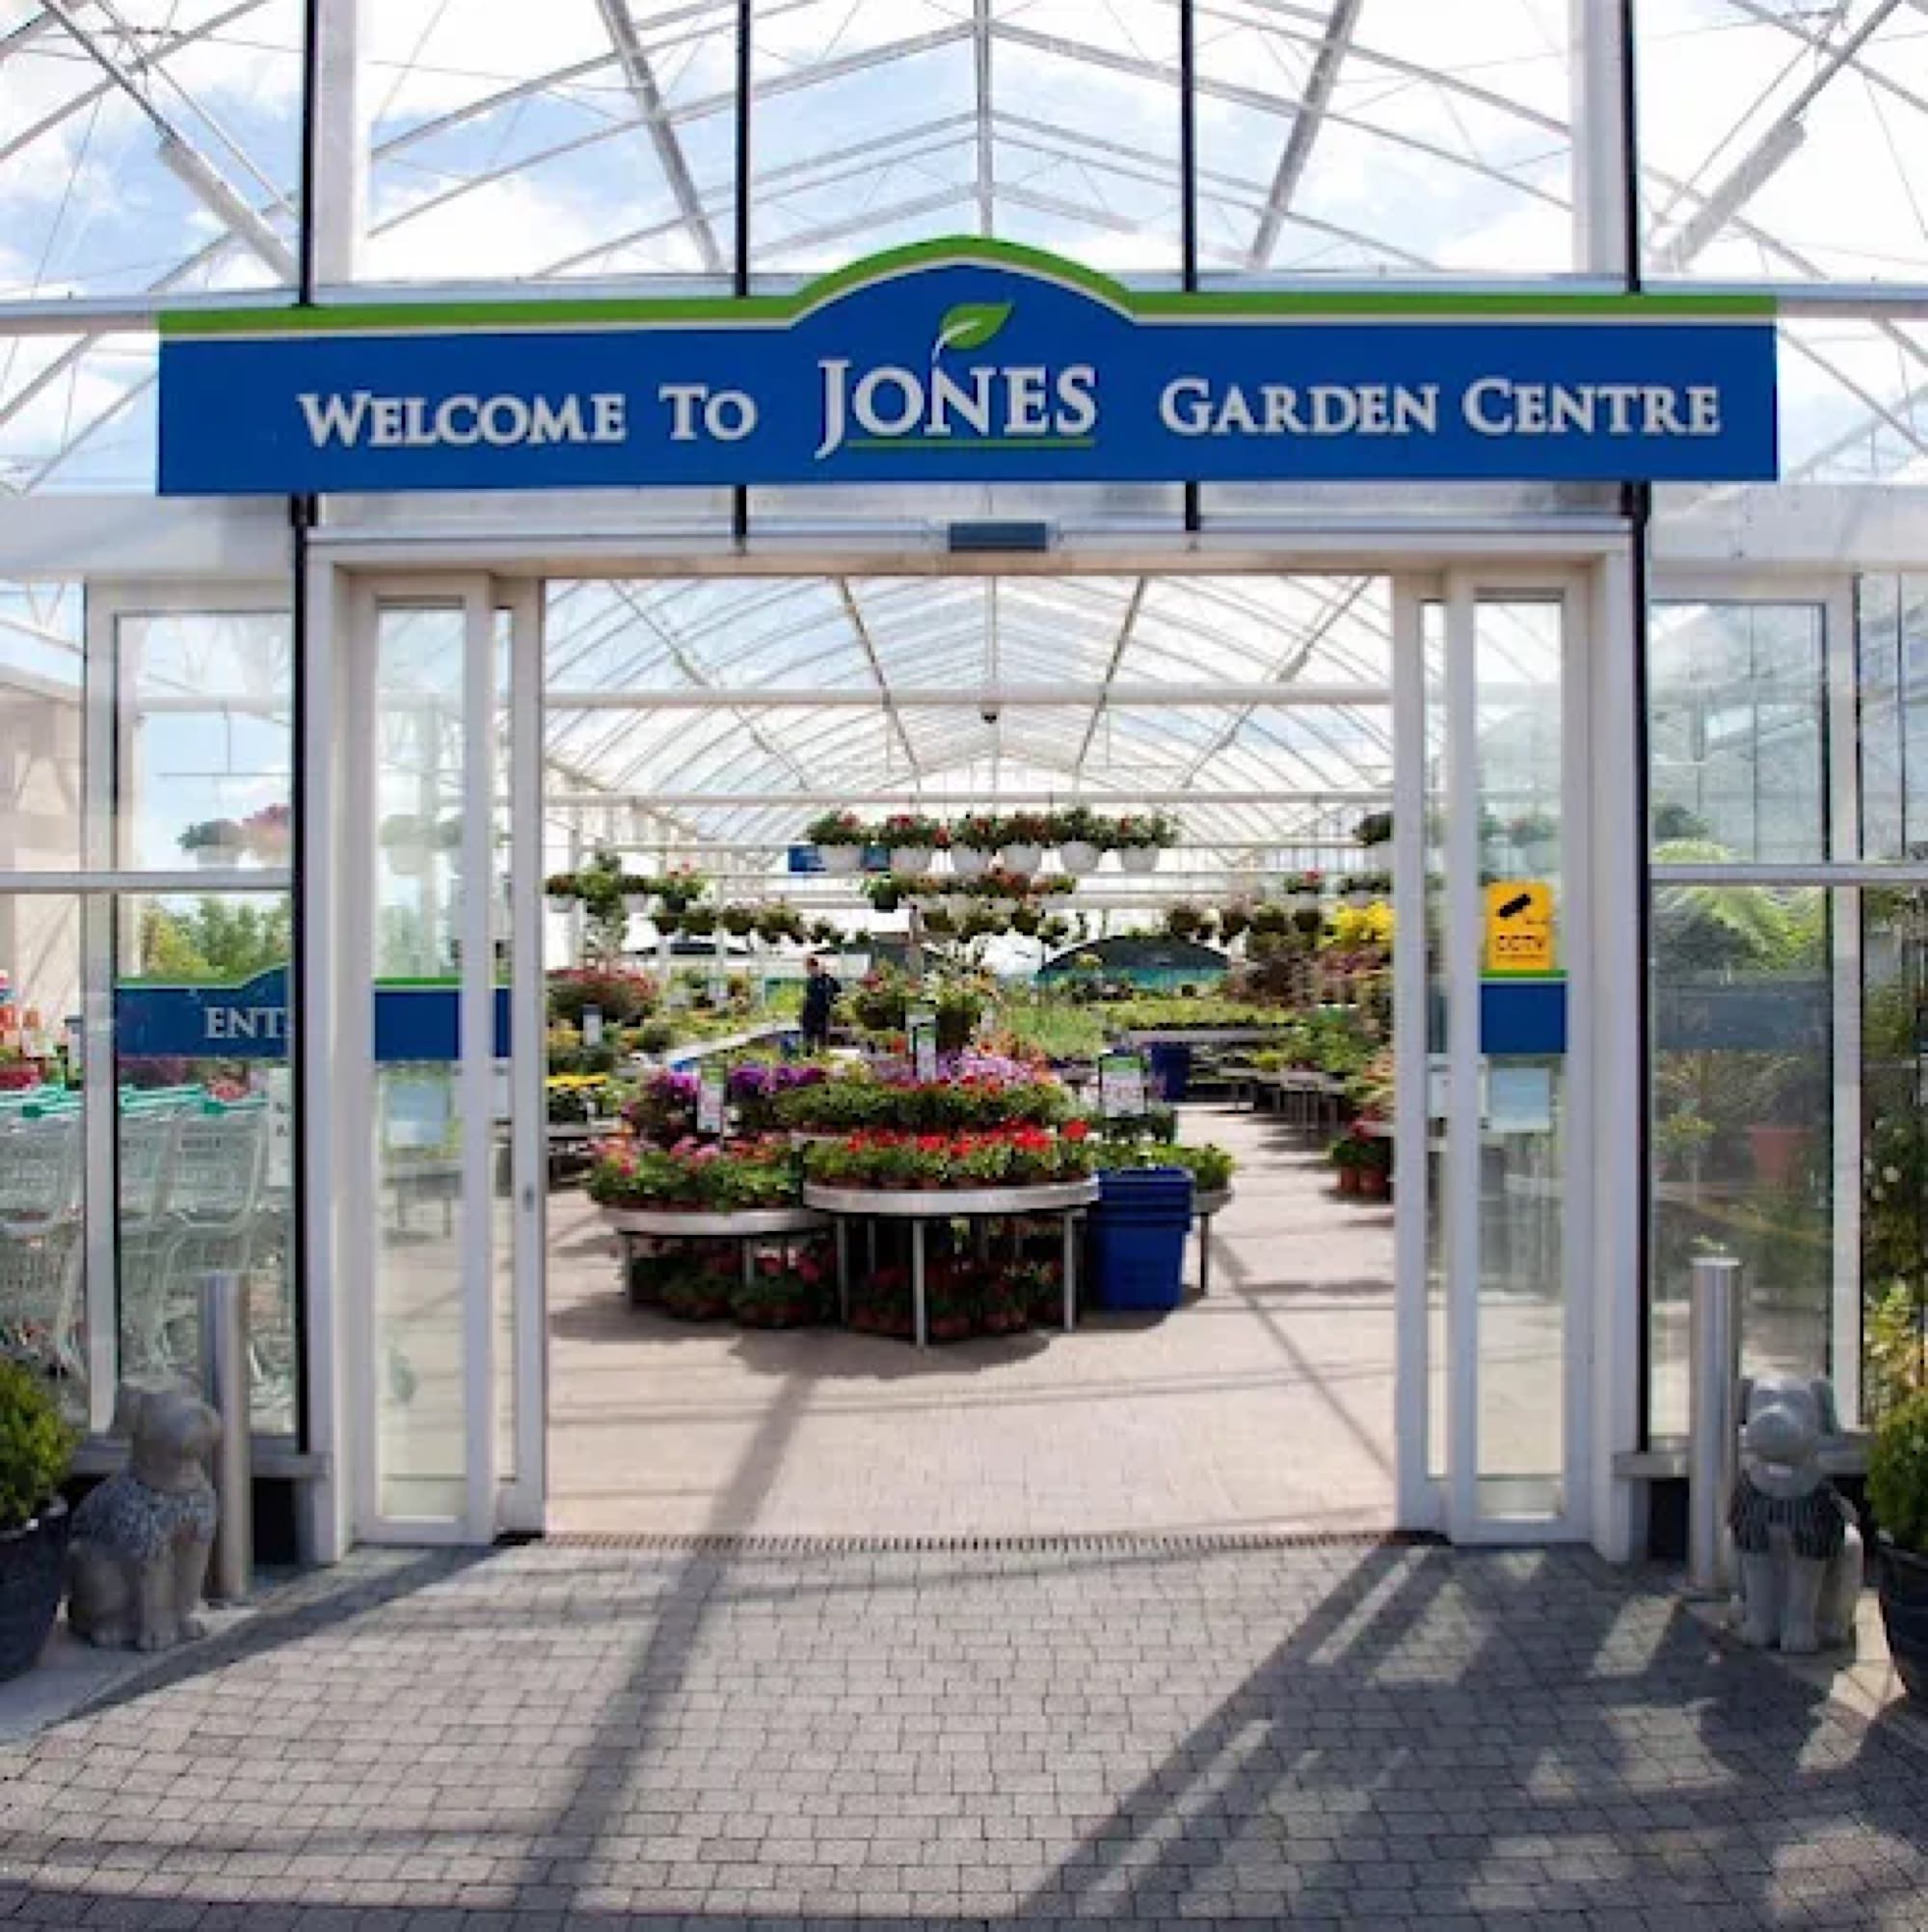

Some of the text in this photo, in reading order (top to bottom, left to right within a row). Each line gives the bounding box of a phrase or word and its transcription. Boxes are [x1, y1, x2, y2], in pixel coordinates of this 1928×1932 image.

[298, 359, 1721, 460] WELCOME TO JONES GARDEN CENTRE
[204, 1006, 293, 1039] ENT
